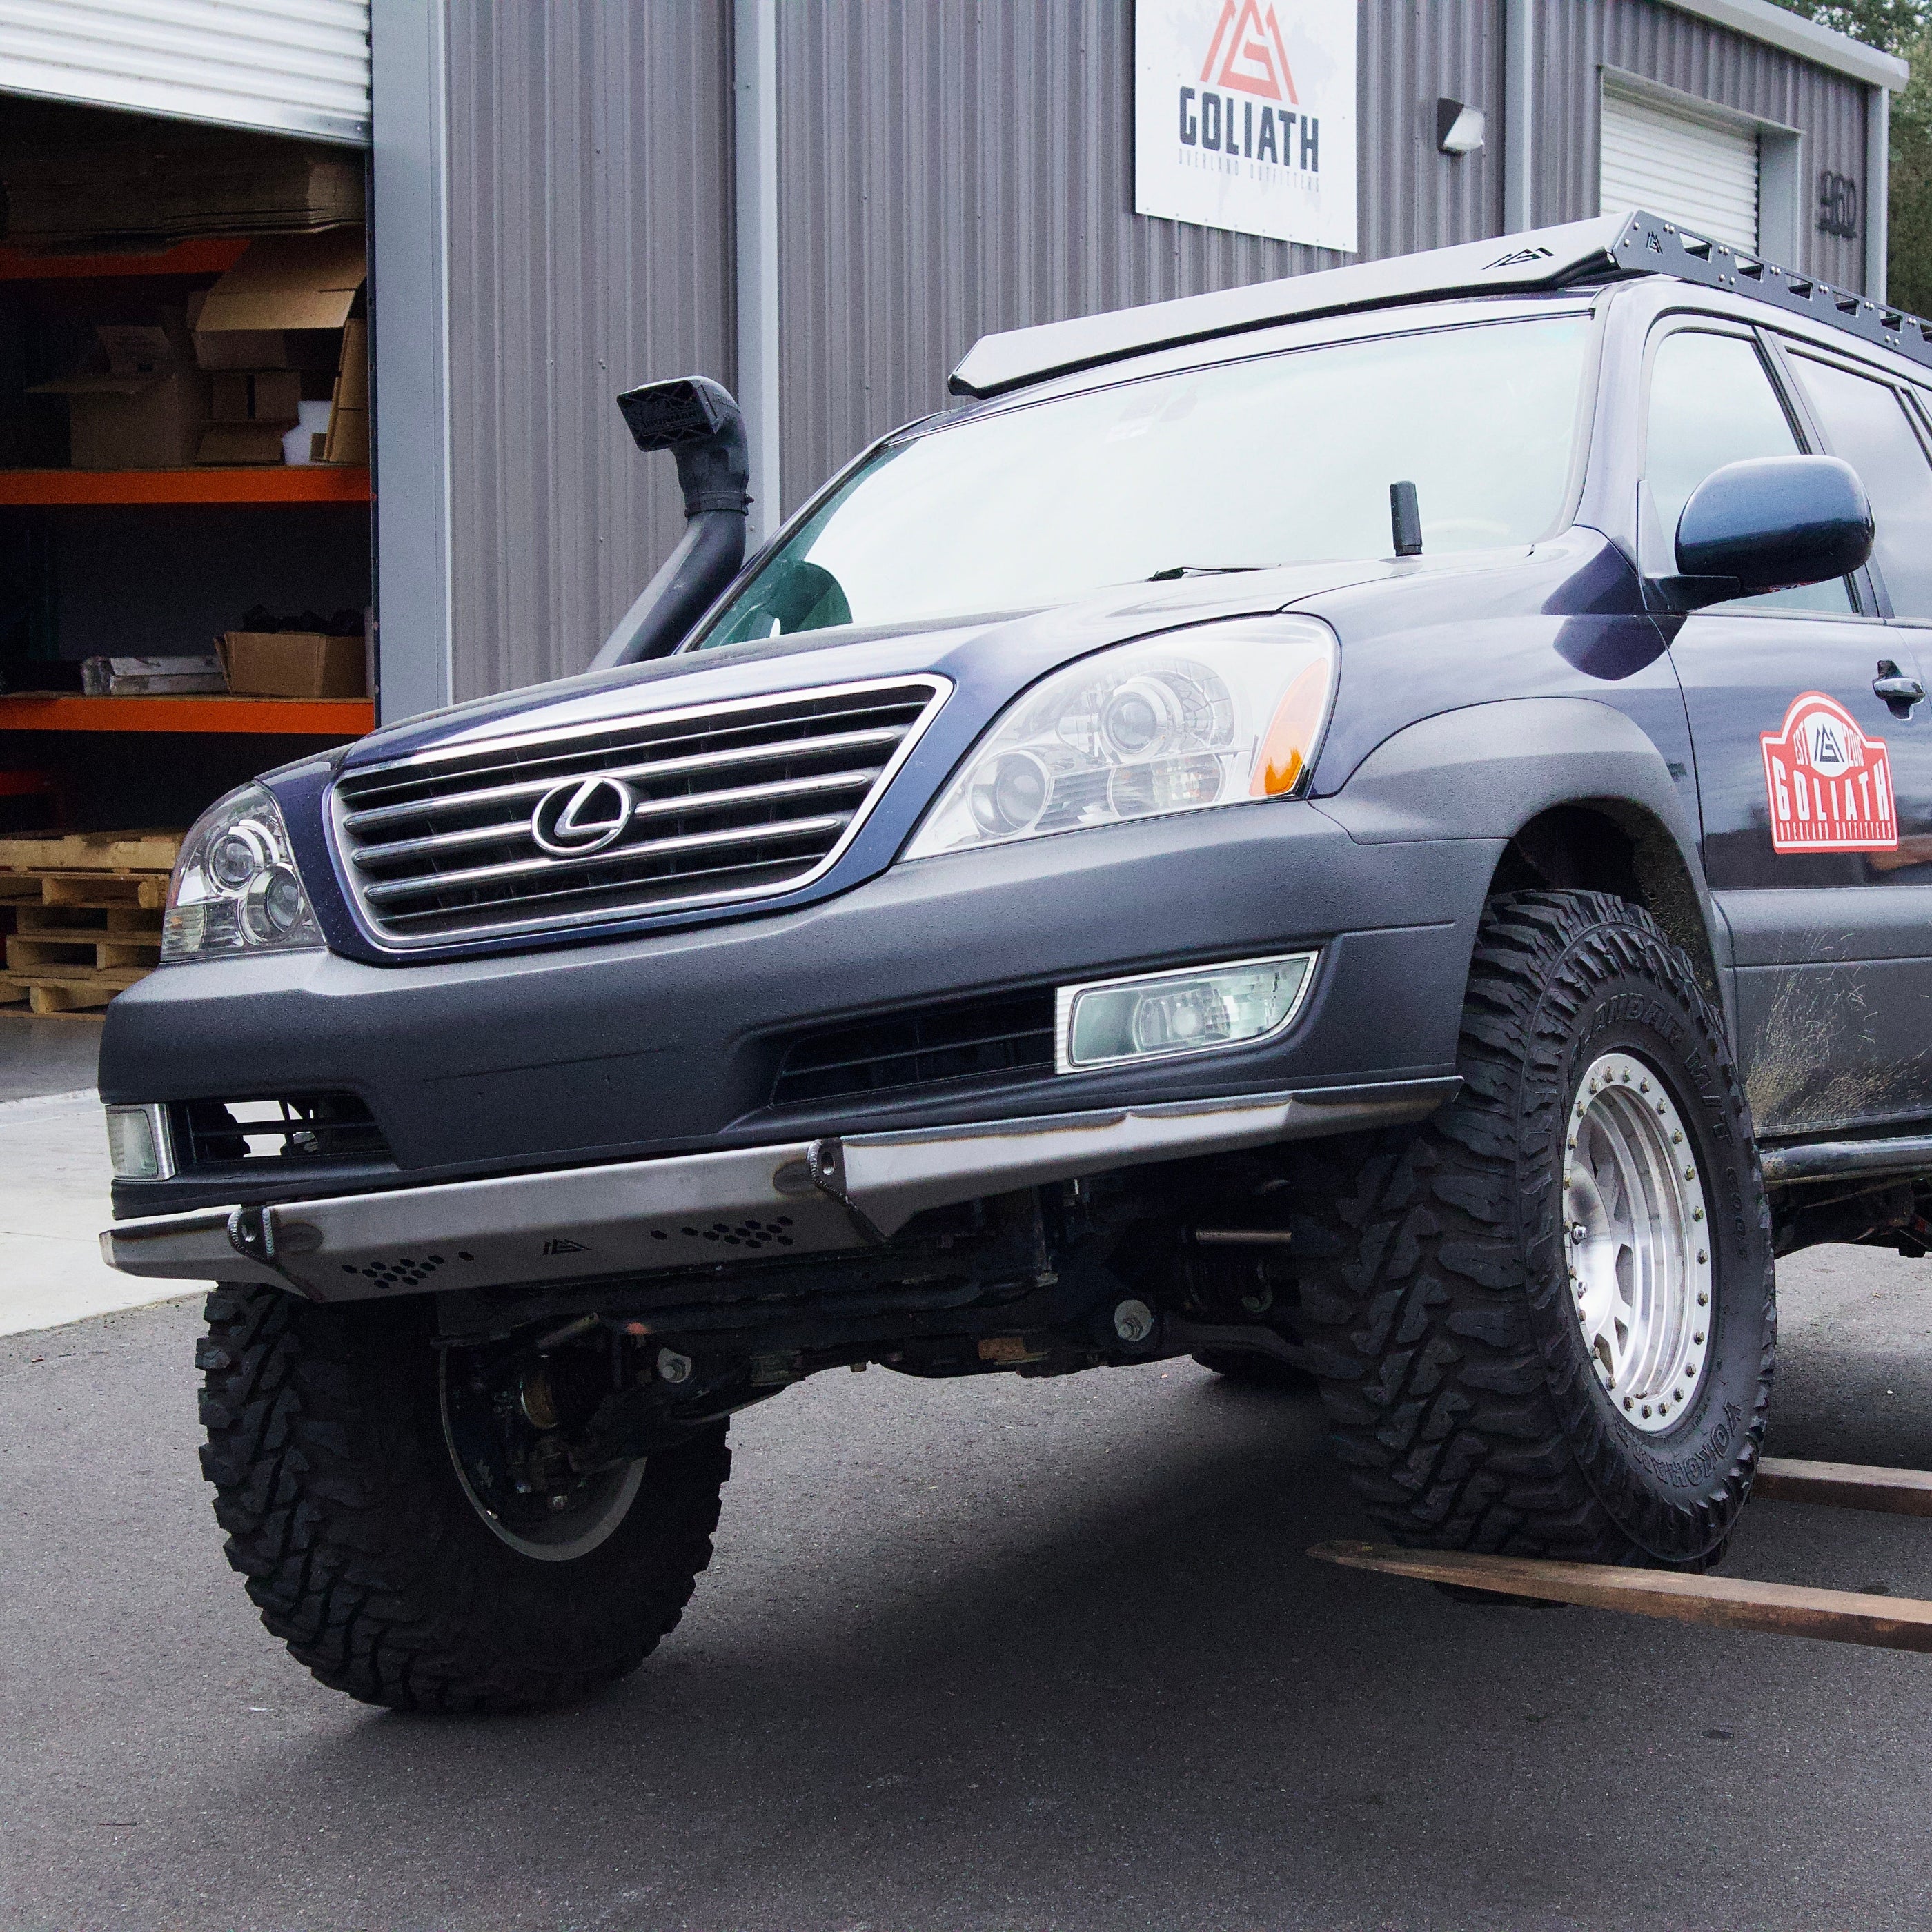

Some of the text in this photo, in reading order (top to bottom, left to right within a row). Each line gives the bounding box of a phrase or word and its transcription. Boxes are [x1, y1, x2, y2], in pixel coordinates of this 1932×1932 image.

[1179, 86, 1319, 172] GOLIATH
[1179, 148, 1319, 193] OVERLAND OUTFITTERS
[1772, 756, 1890, 821] GOLIATH
